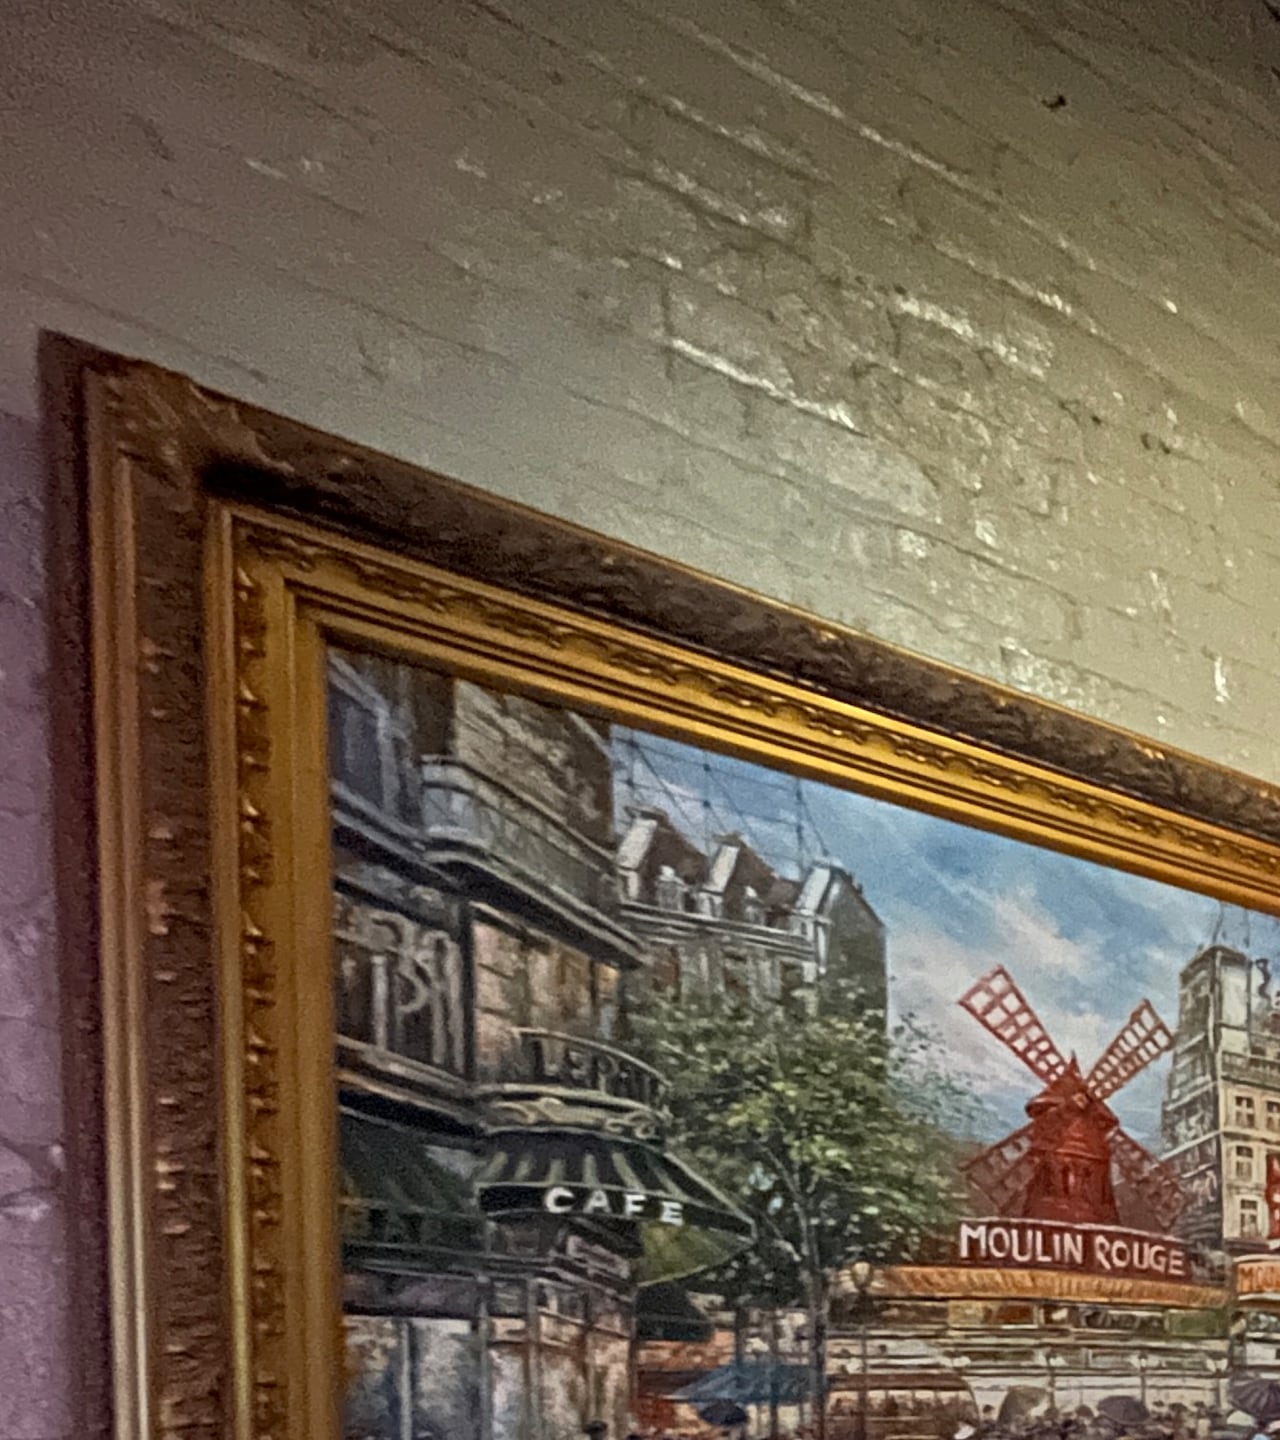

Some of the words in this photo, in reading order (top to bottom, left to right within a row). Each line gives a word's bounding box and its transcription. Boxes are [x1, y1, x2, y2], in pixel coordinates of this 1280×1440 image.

[544, 1186, 684, 1226] CAFE
[960, 1222, 1083, 1264] MOULIN
[1093, 1233, 1185, 1276] ROUGE
